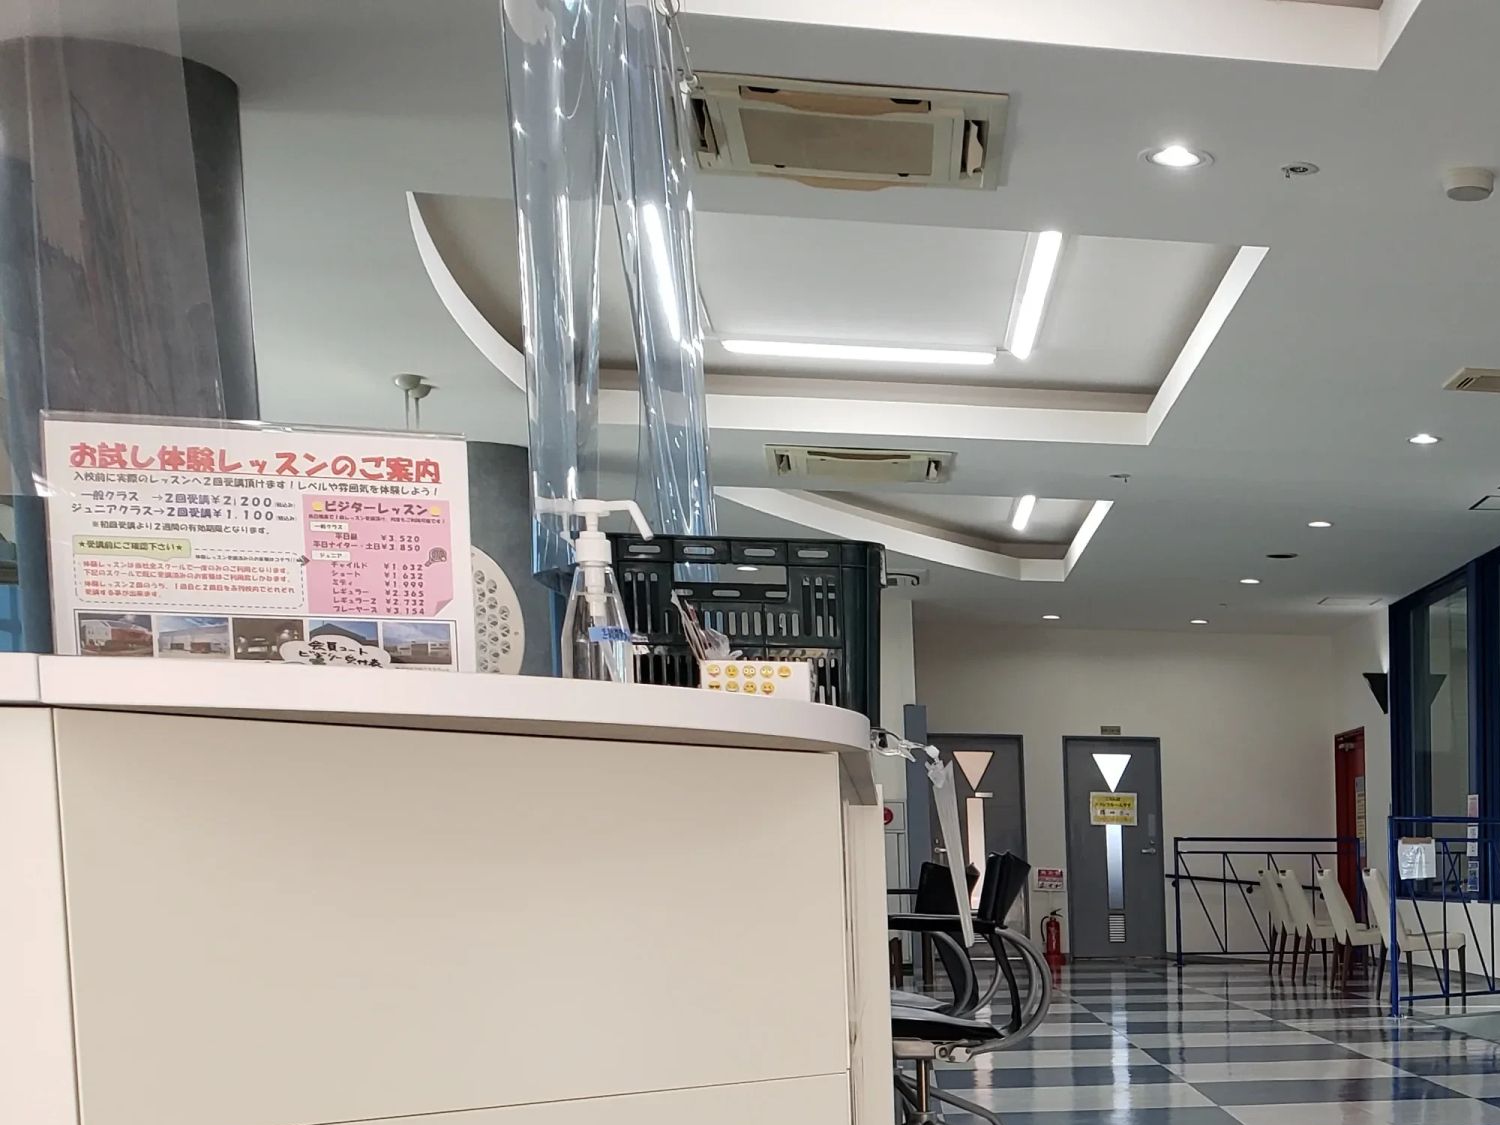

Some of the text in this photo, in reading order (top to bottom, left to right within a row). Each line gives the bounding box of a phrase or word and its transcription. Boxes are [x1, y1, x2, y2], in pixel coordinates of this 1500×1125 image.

[70, 442, 441, 483] お試し体験レッスンのご案内
[81, 490, 139, 502] 一般クラス
[325, 500, 428, 516] ビジターレッスン
